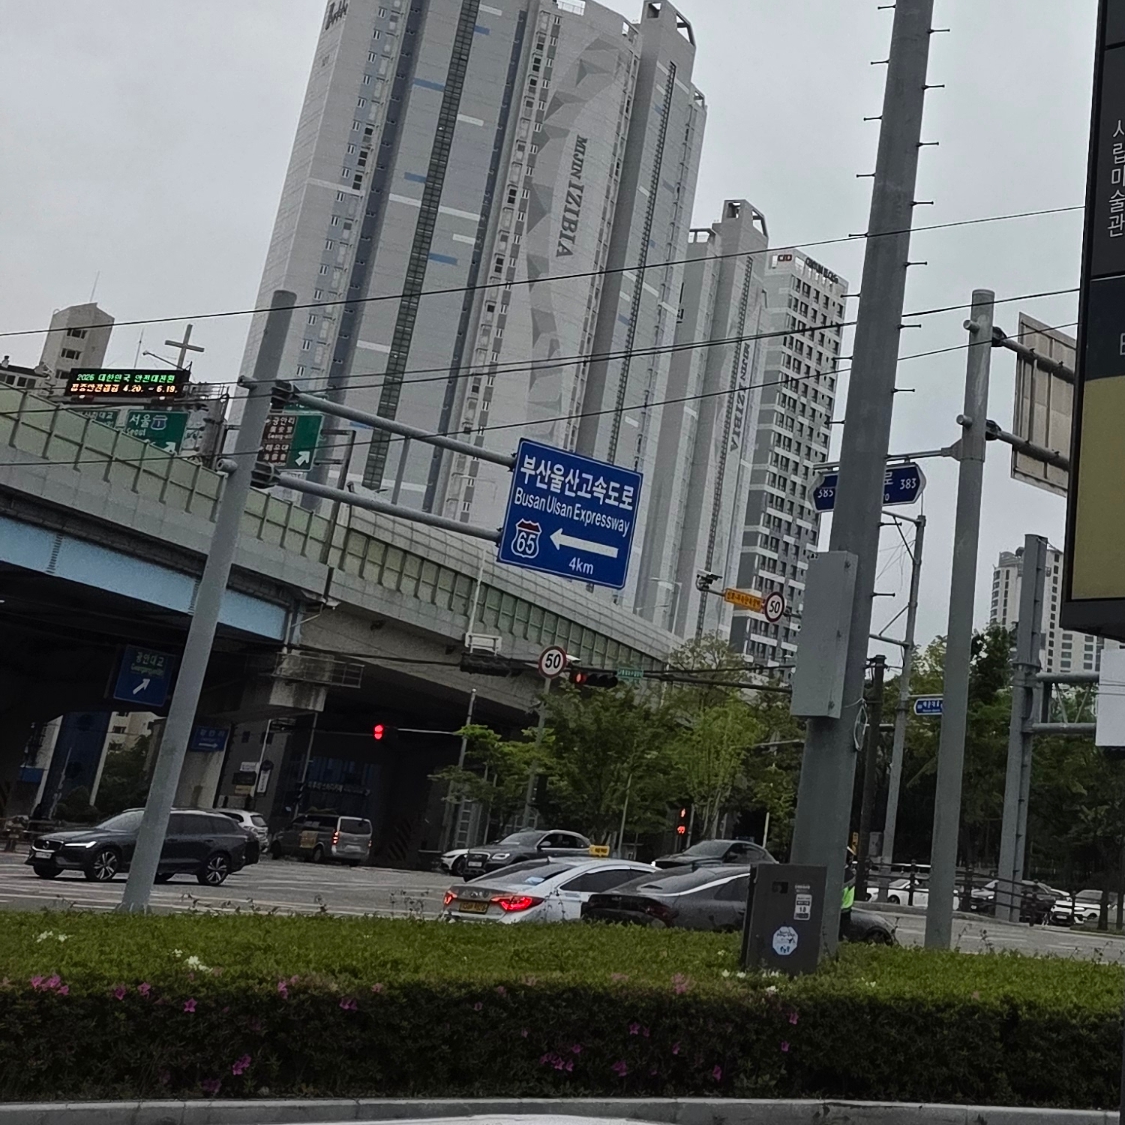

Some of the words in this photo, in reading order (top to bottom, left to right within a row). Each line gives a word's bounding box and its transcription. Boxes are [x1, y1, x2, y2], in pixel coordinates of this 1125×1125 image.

[570, 134, 588, 181] MIJIN
[556, 180, 584, 258] IZIBIA
[128, 414, 151, 428] 서울
[520, 454, 634, 511] 부산울산고속도로
[900, 478, 916, 490] 383
[514, 486, 546, 512] Busan
[546, 495, 572, 520] Ulsan
[573, 504, 630, 538] Expressway
[516, 532, 536, 554] 65
[568, 556, 594, 575] 4km
[768, 600, 780, 614] 50
[544, 654, 561, 669] 50
